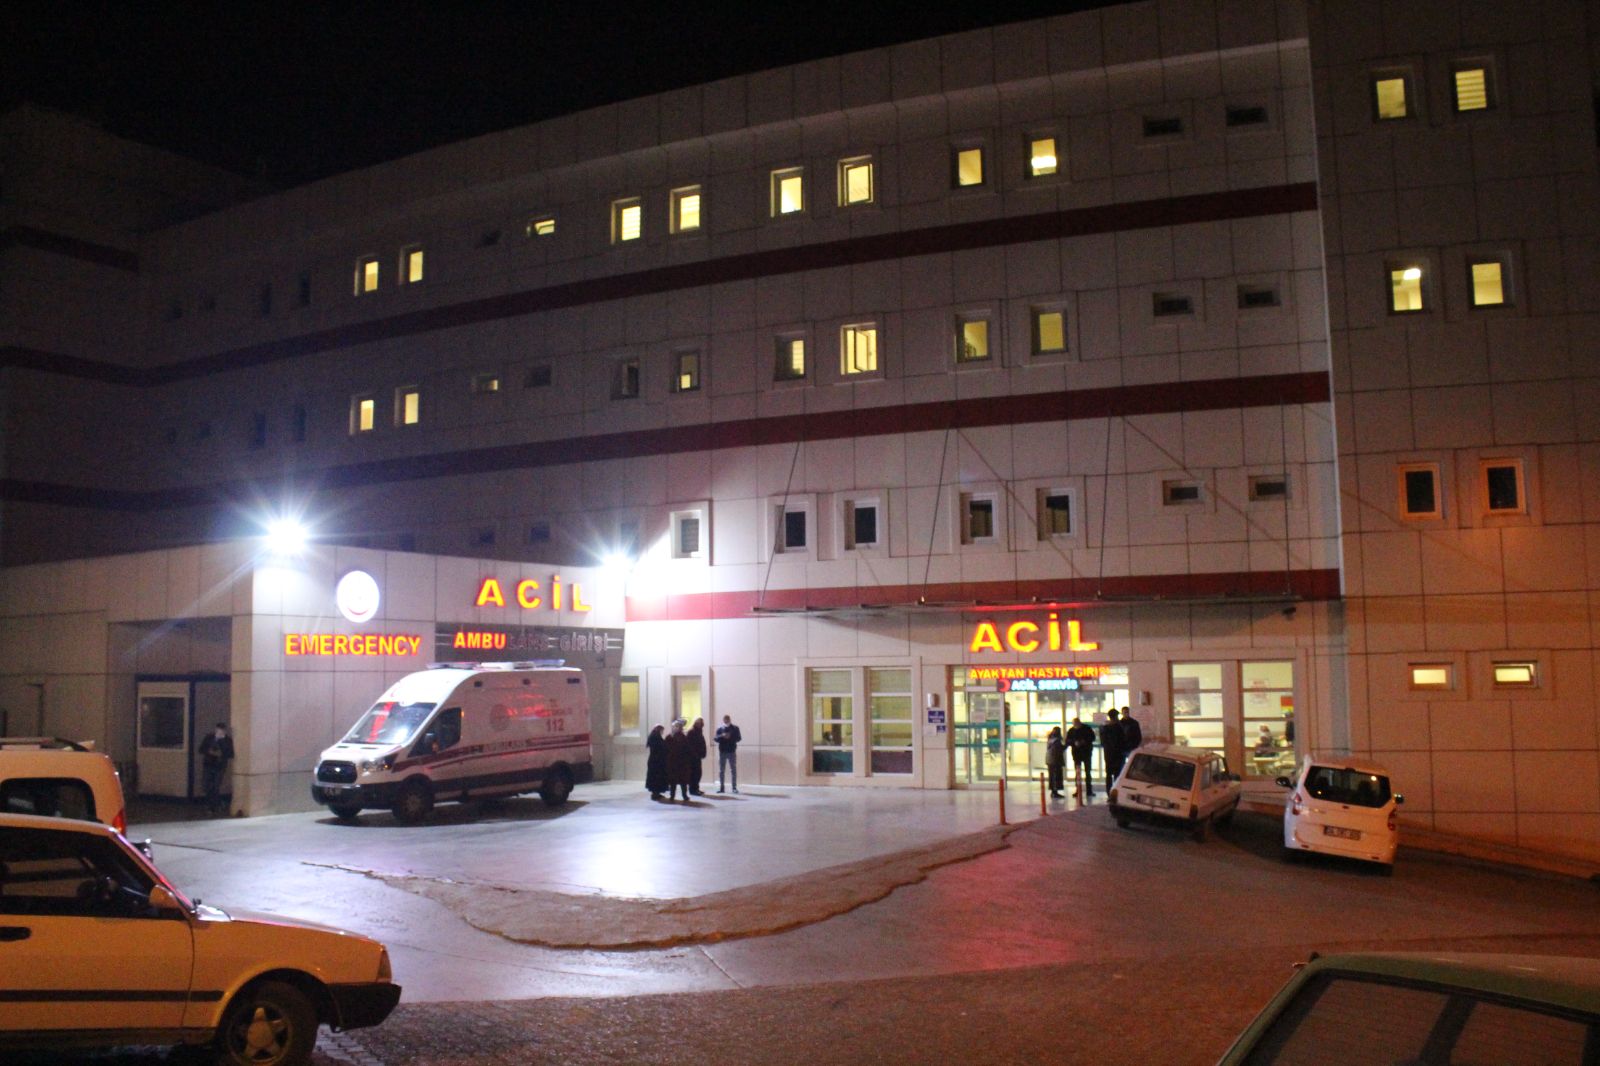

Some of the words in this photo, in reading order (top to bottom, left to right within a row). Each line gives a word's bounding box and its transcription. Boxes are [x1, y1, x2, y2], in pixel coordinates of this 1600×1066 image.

[476, 575, 592, 612] ACİL
[284, 633, 422, 656] EMERGENCY
[969, 613, 1099, 653] ACİL
[969, 667, 1025, 680] AYAKTAN
[1028, 666, 1070, 679] HASTA
[546, 718, 565, 732] 112
